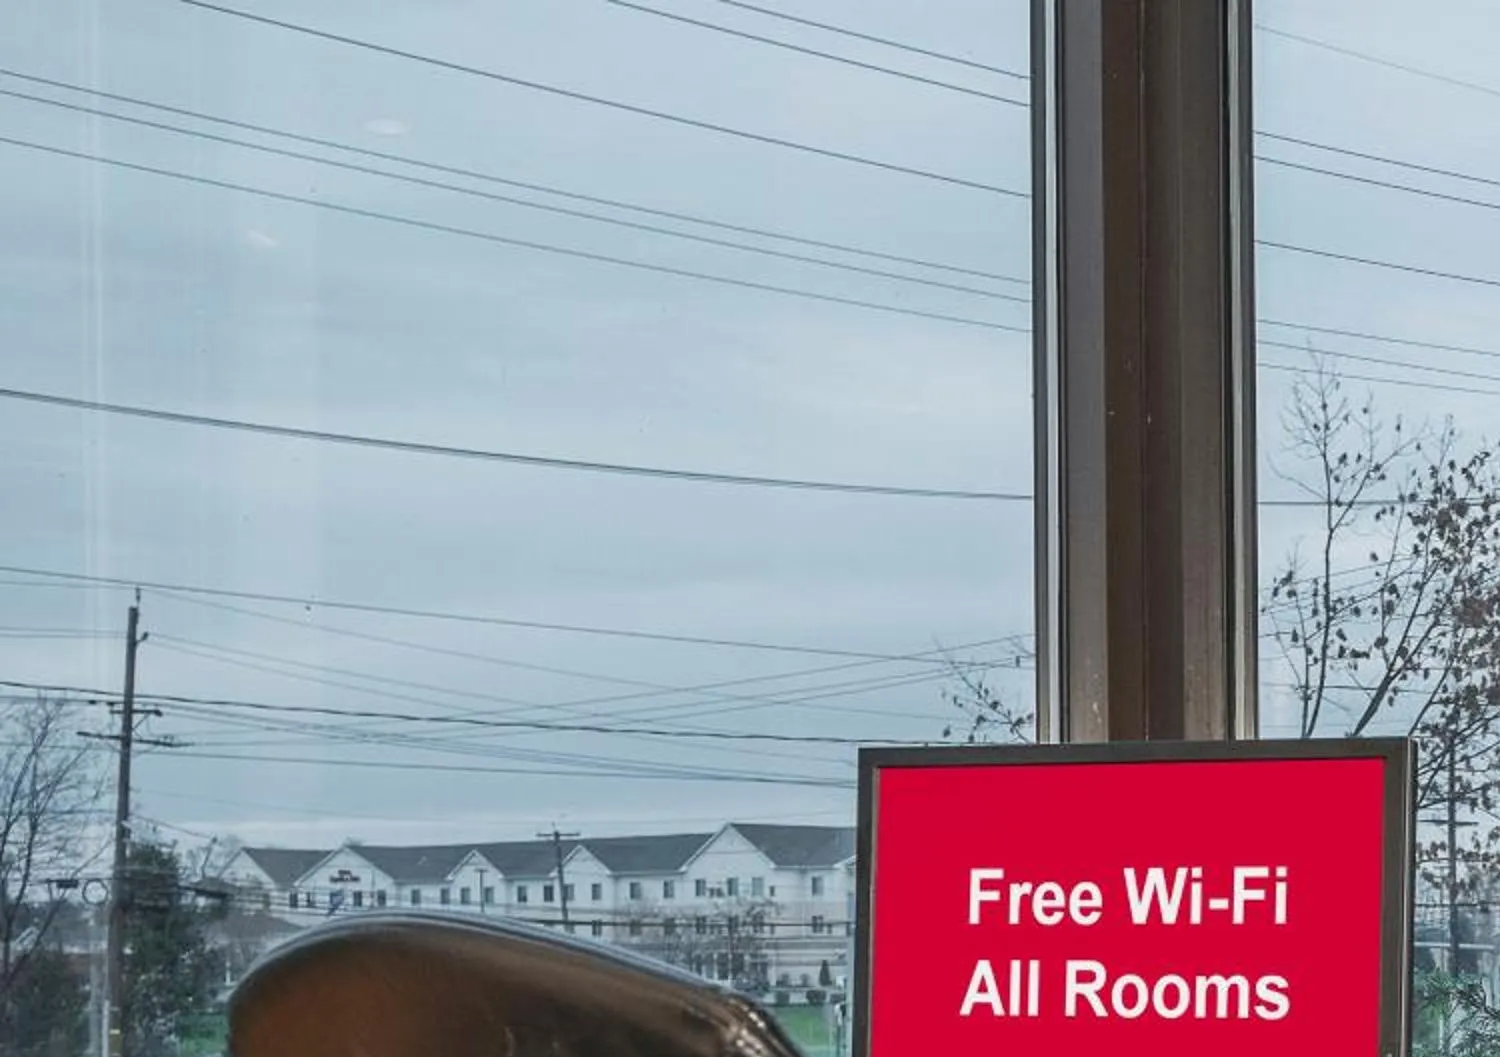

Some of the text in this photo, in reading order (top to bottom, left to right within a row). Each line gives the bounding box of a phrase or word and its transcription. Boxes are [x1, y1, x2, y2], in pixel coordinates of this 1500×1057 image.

[969, 866, 1289, 926] Free Wi-Fi
[959, 959, 1291, 1021] All Rooms
